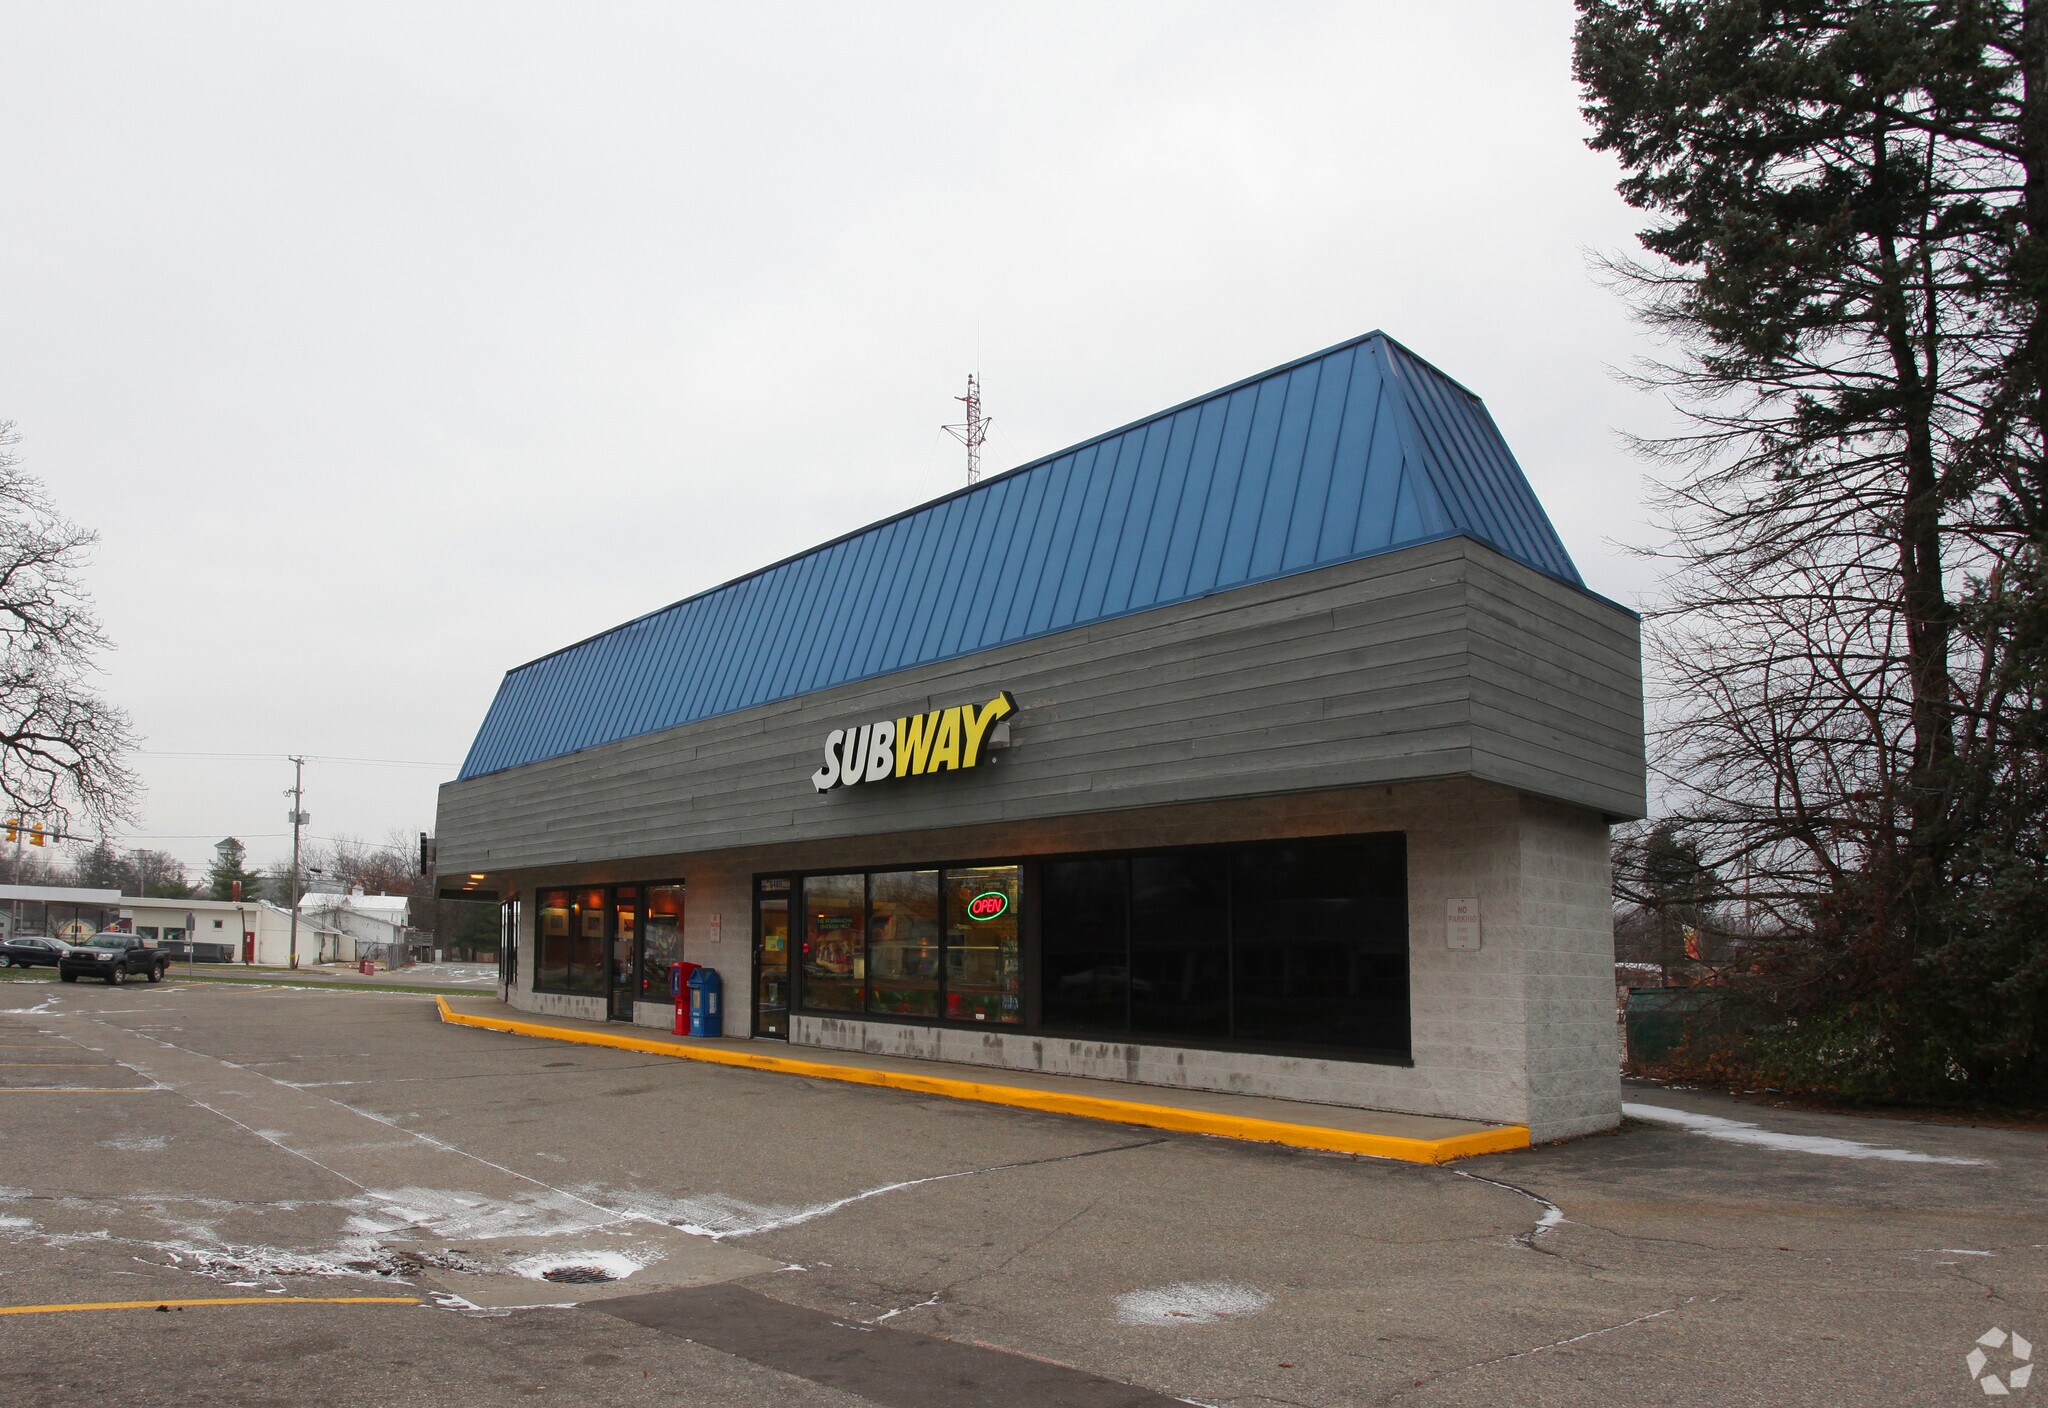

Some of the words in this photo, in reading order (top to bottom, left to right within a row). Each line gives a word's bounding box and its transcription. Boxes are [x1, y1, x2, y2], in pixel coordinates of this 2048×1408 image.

[811, 691, 1013, 793] SUBWAY
[972, 898, 1002, 914] OPEN
[1448, 915, 1476, 923] PARKING
